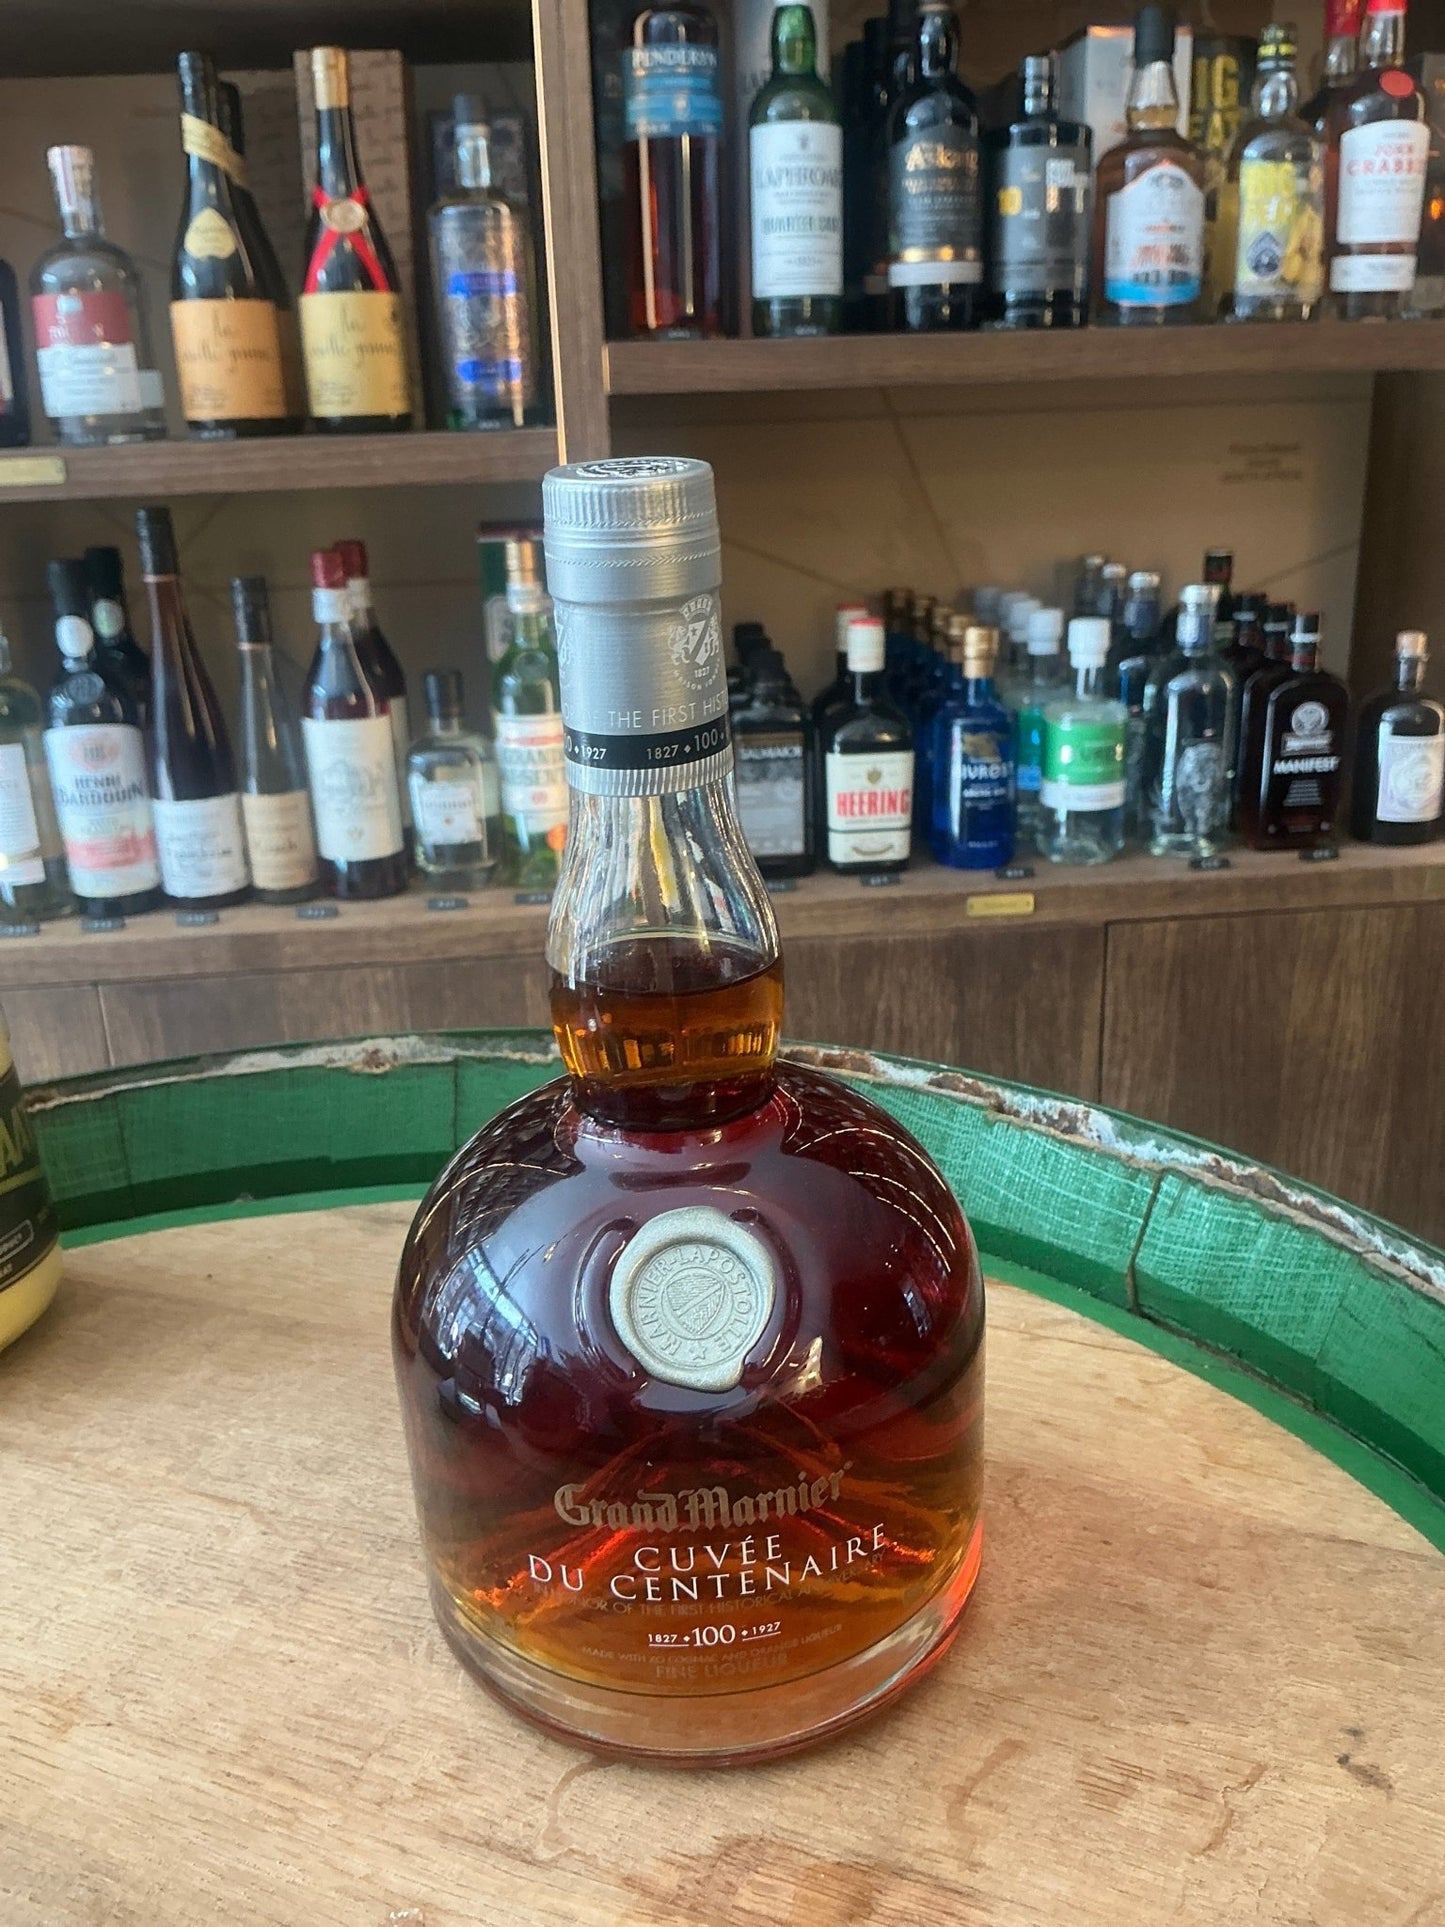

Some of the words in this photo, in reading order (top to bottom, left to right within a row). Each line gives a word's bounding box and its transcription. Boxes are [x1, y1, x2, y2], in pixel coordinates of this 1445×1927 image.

[608, 710, 642, 729] THE
[652, 703, 696, 726] FIRST
[580, 745, 607, 760] 1927
[647, 744, 679, 760] 1827
[1273, 756, 1341, 775] MANIFEST
[75, 773, 122, 790] HENRI
[836, 788, 910, 817] HEERING
[554, 1483, 679, 1533] Grand
[678, 1469, 846, 1533] Marnier
[528, 1553, 584, 1592] DU
[610, 1523, 885, 1601] CENTENAIRE
[633, 1535, 782, 1572] CUVÉE
[612, 1601, 634, 1614] OF
[640, 1602, 665, 1616] THE
[648, 1633, 678, 1643] 1827
[691, 1624, 736, 1647] 100
[752, 1621, 781, 1636] 1927
